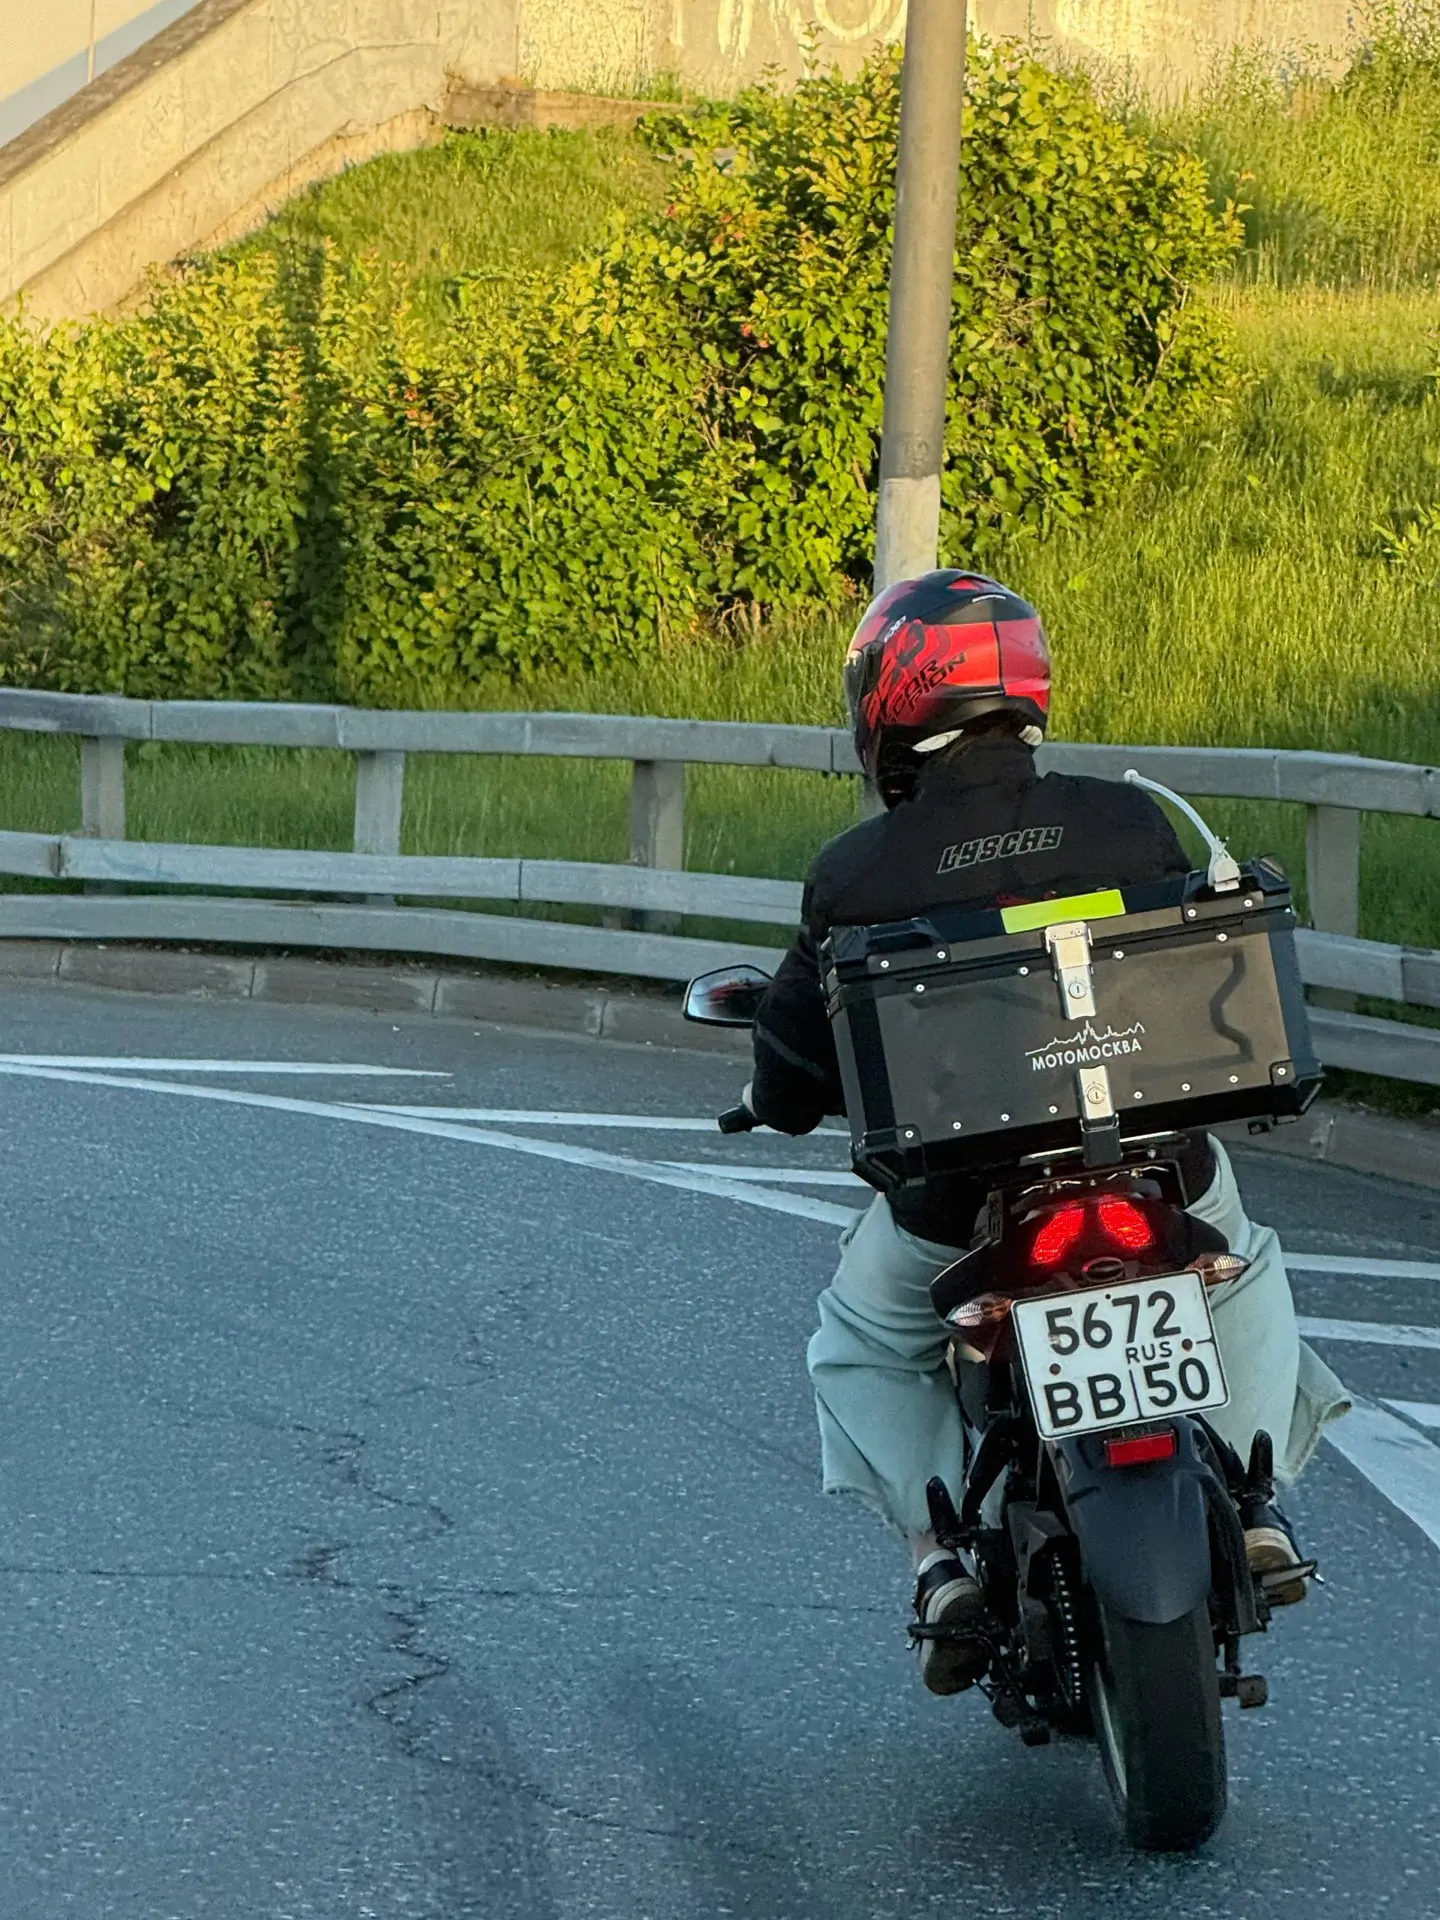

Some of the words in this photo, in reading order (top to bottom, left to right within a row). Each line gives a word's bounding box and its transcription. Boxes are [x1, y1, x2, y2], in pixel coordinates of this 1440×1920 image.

[1032, 1038, 1142, 1072] МОТОМОСКВА
[1045, 1290, 1182, 1356] 5672
[1125, 1341, 1173, 1365] RUS
[1143, 1357, 1210, 1408] 50
